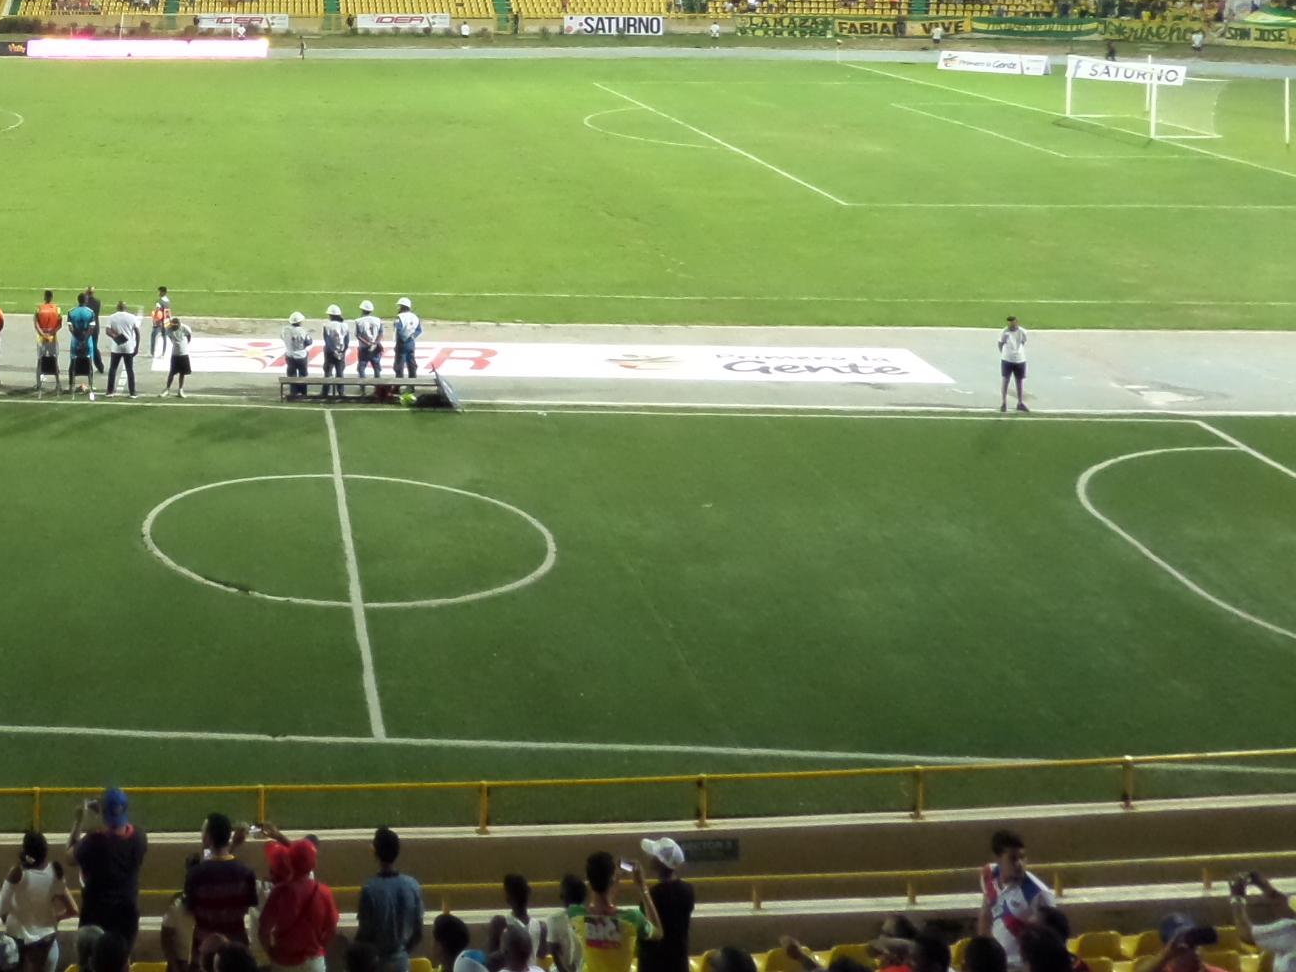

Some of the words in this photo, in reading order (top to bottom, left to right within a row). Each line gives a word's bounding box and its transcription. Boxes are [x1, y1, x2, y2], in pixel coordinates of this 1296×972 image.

[584, 16, 661, 34] SATURNO
[1089, 64, 1179, 82] SATURNO
[722, 360, 910, 376] Gente
